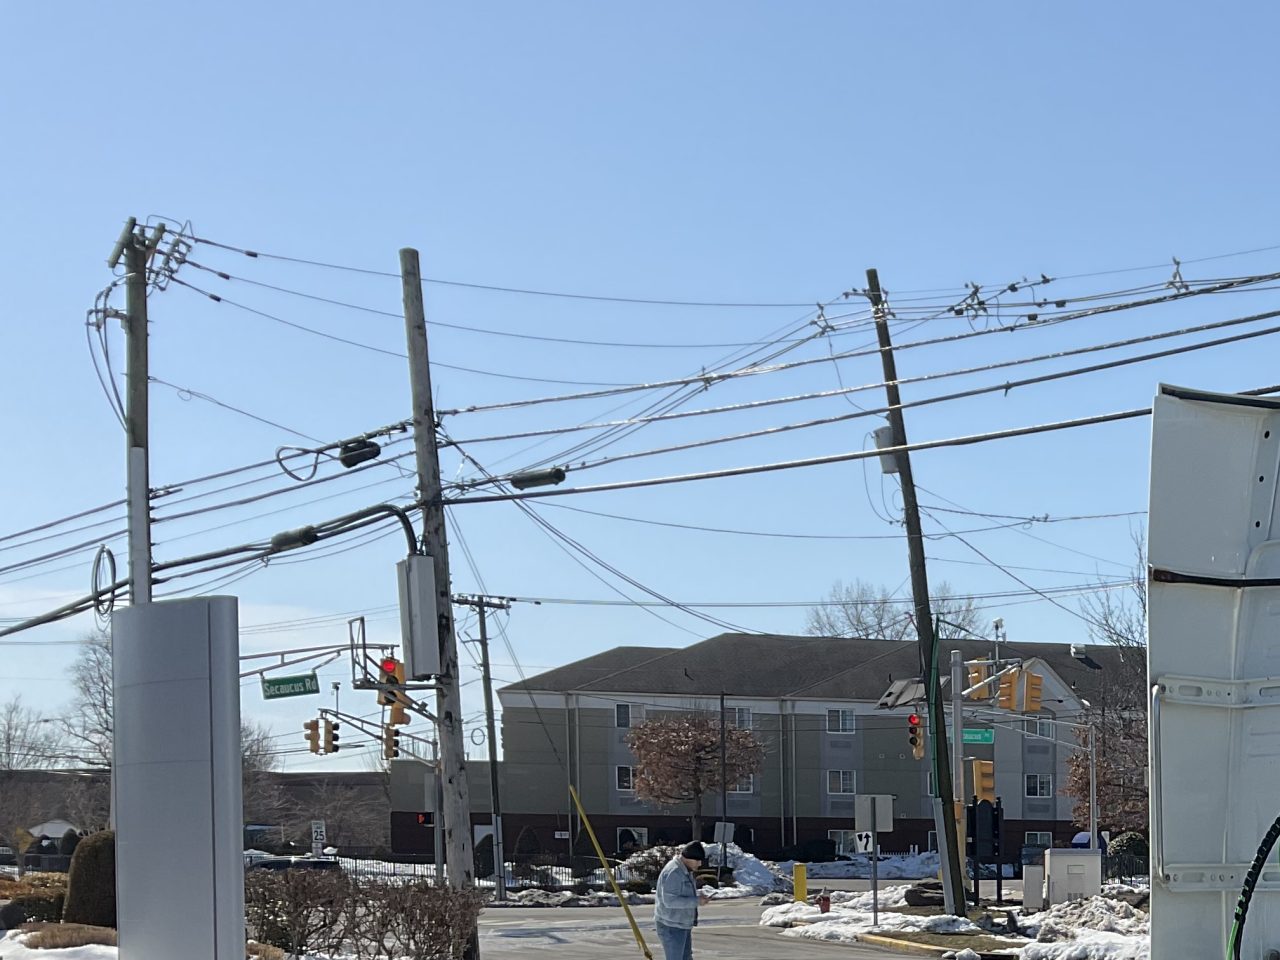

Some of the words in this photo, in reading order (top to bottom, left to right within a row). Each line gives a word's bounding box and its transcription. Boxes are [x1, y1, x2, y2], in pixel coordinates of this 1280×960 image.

[264, 682, 304, 696] Secaucus
[304, 678, 317, 691] Rd
[314, 830, 325, 841] 25
